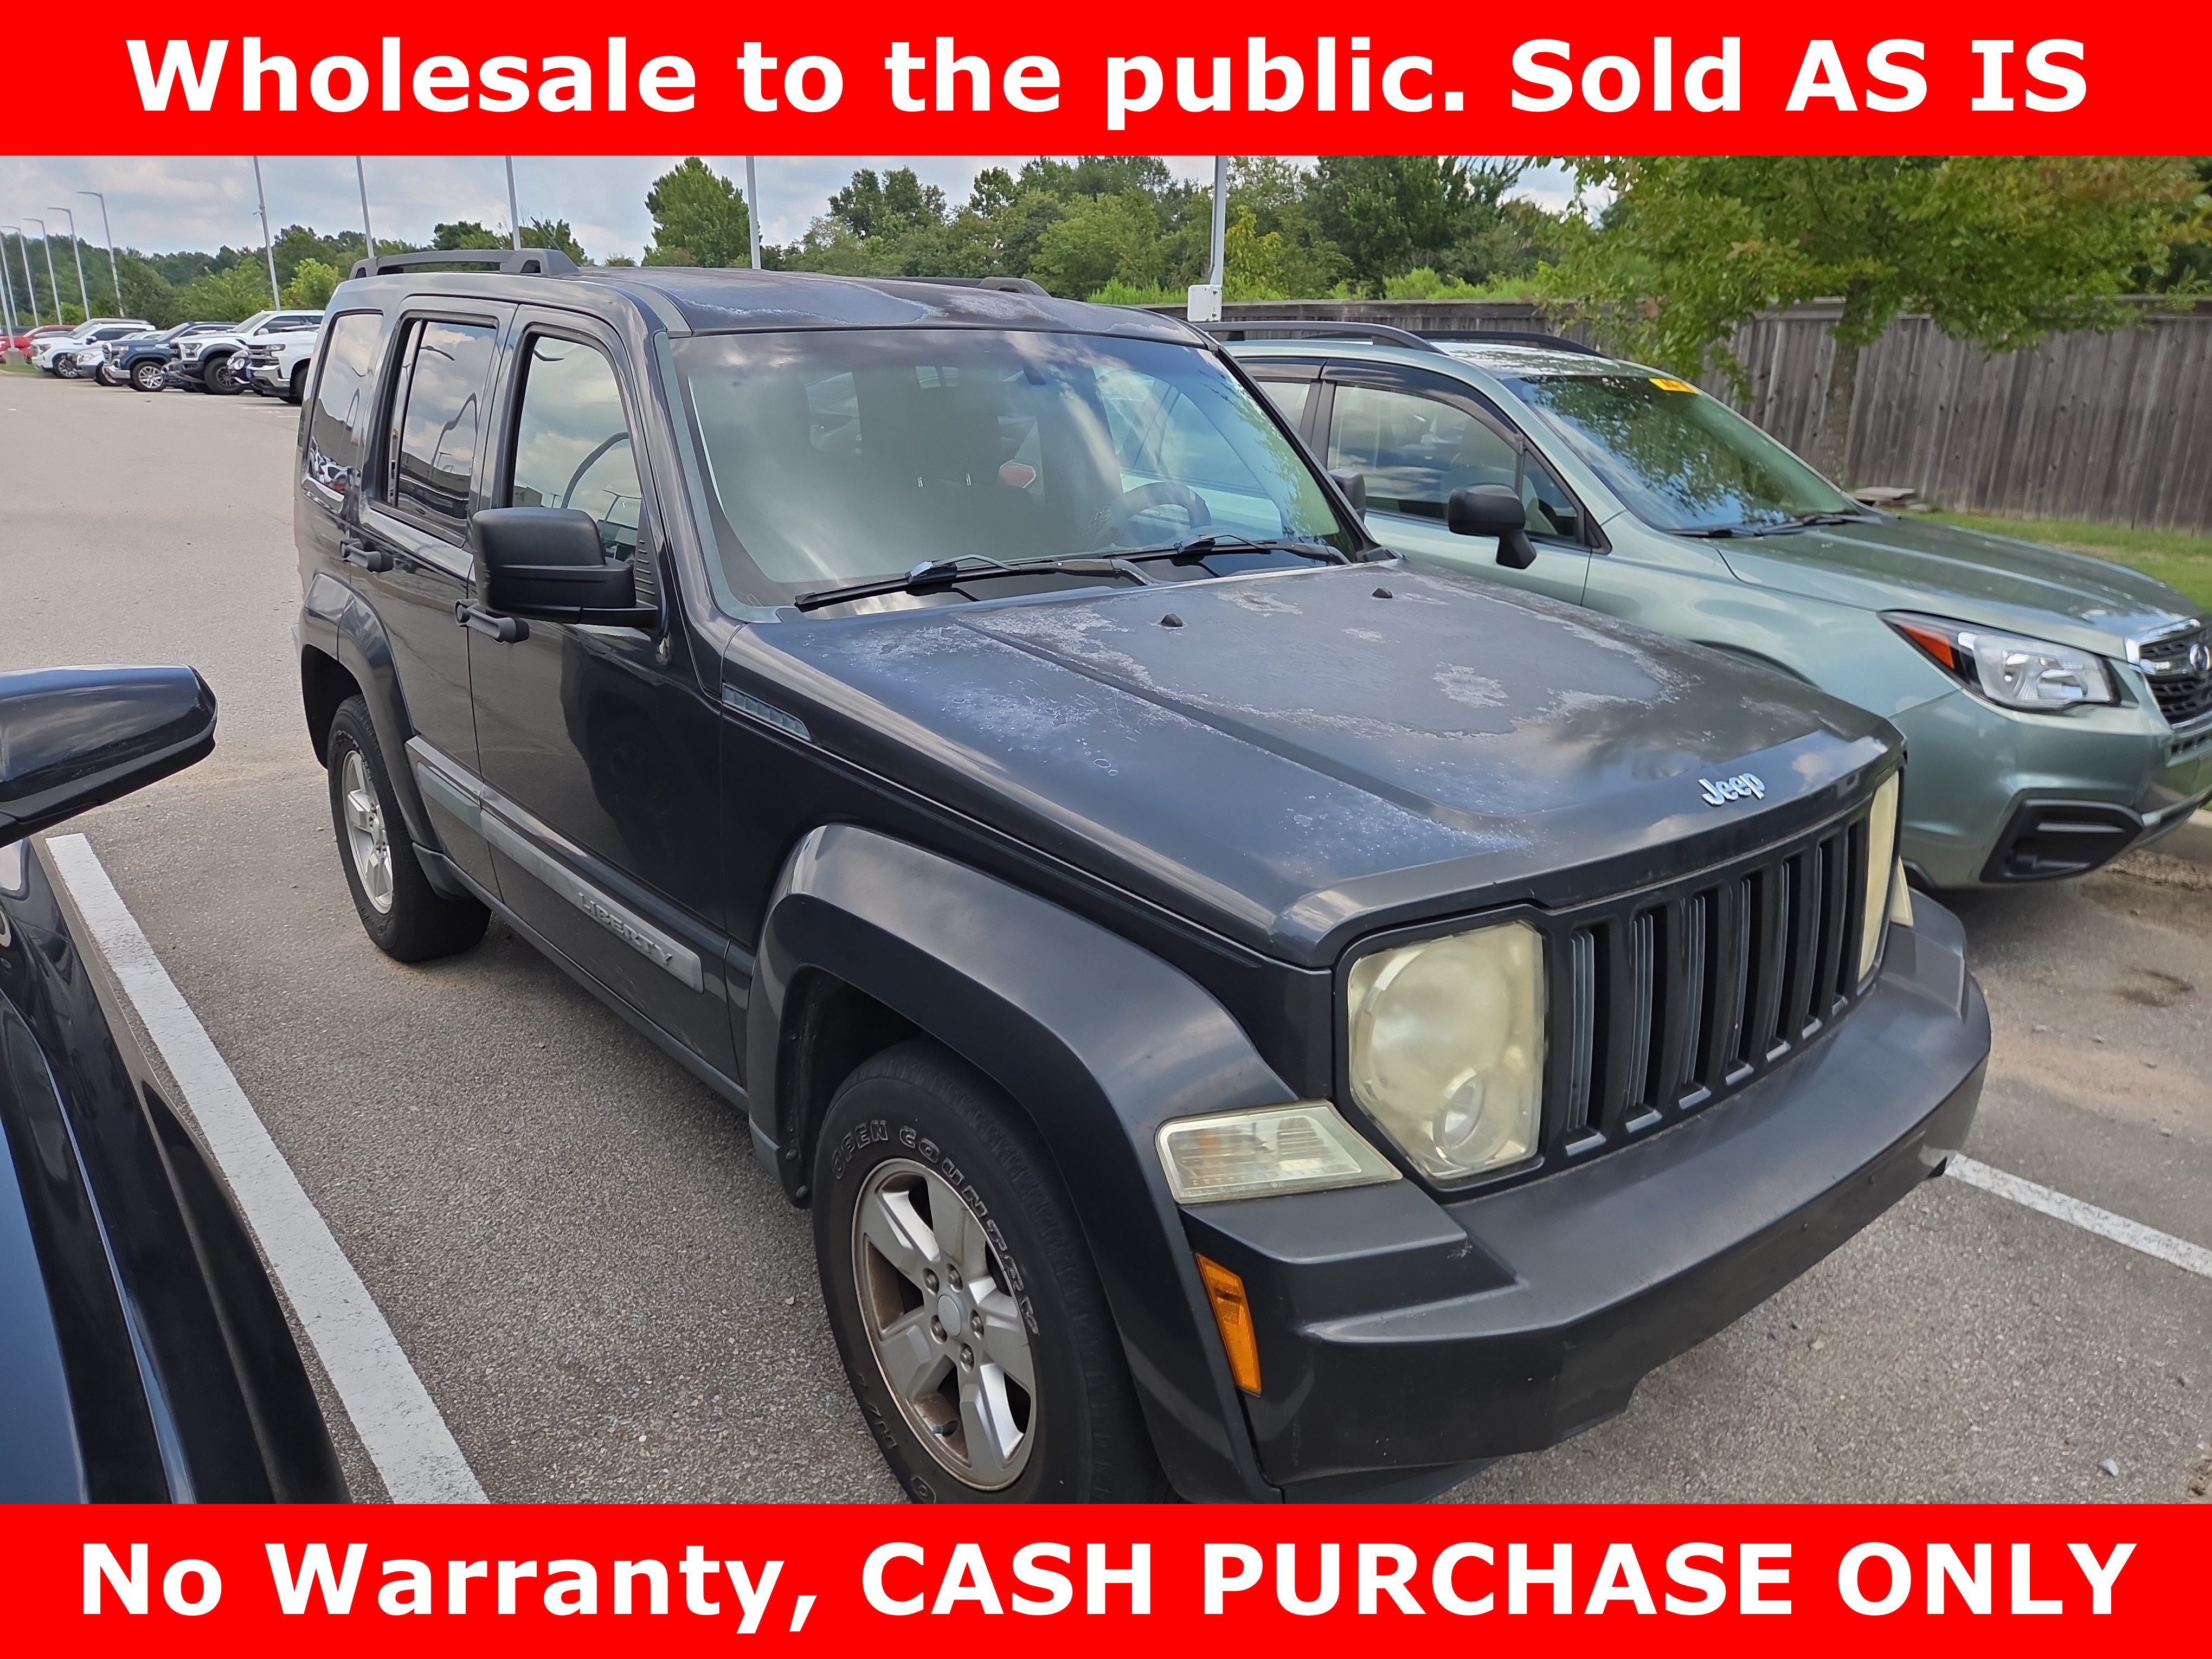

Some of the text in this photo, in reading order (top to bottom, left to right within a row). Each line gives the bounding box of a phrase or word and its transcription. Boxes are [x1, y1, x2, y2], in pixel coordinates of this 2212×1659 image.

[1698, 773, 1765, 805] Jeep
[578, 891, 673, 966] LIBERTY
[832, 1119, 1039, 1336] OPEN COUNTRY
